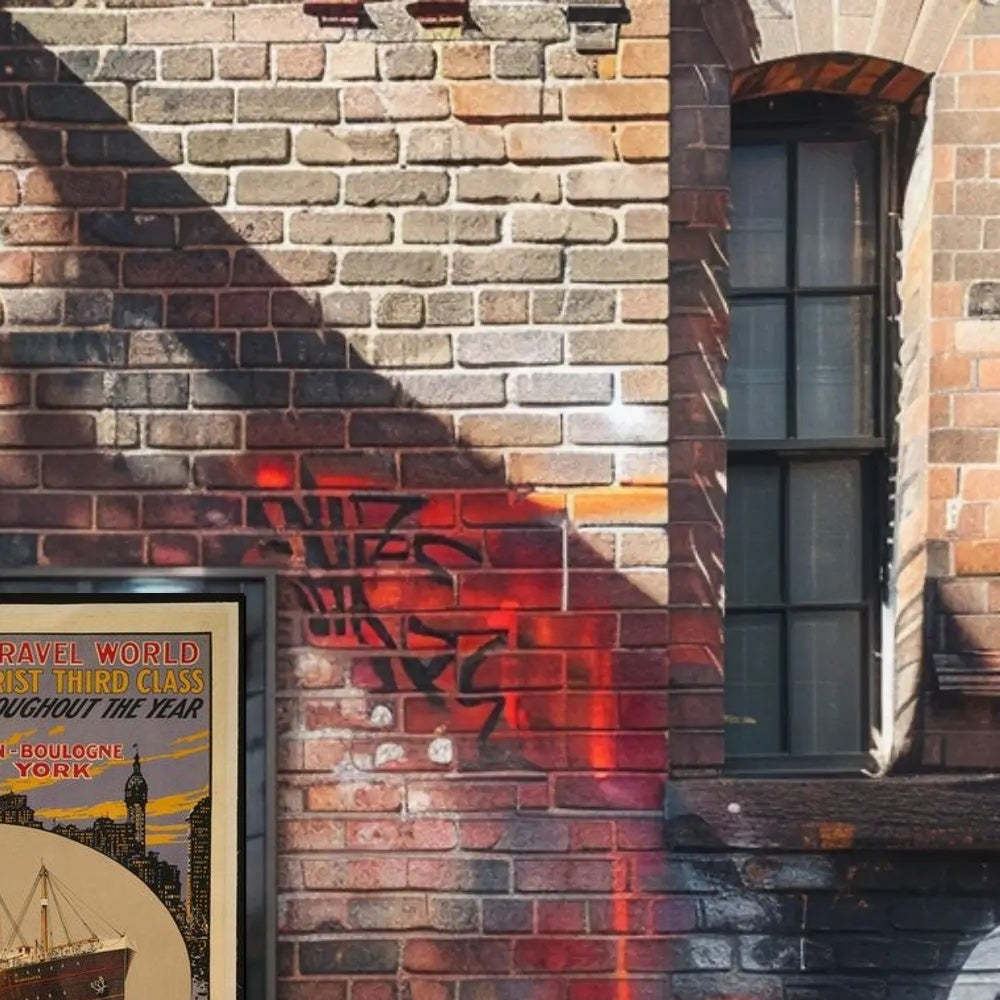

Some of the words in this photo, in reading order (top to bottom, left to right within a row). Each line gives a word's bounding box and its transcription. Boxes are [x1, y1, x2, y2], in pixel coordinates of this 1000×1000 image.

[95, 641, 200, 667] WORLD
[52, 668, 129, 695] THIRD
[136, 668, 205, 695] CLASS
[101, 698, 143, 719] THE
[144, 698, 204, 719] YEAR
[13, 761, 92, 780] YORK
